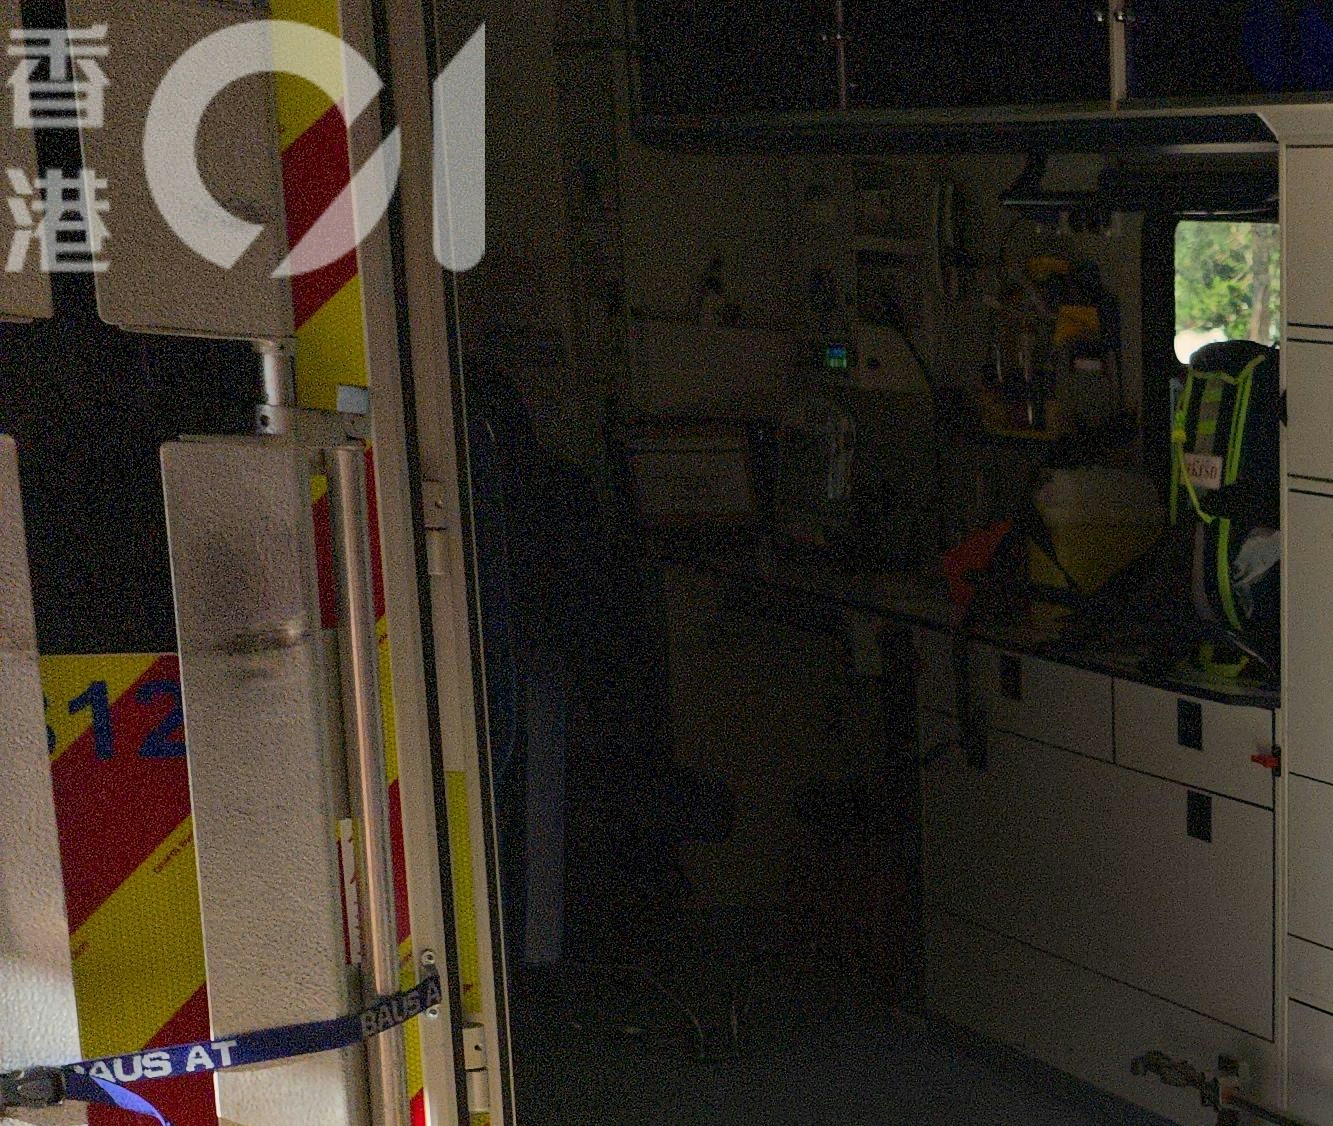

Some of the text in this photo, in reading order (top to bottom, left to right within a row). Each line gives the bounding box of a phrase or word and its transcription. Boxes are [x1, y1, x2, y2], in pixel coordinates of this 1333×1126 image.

[44, 679, 187, 760] 12
[73, 1040, 237, 1083] AUS AT
